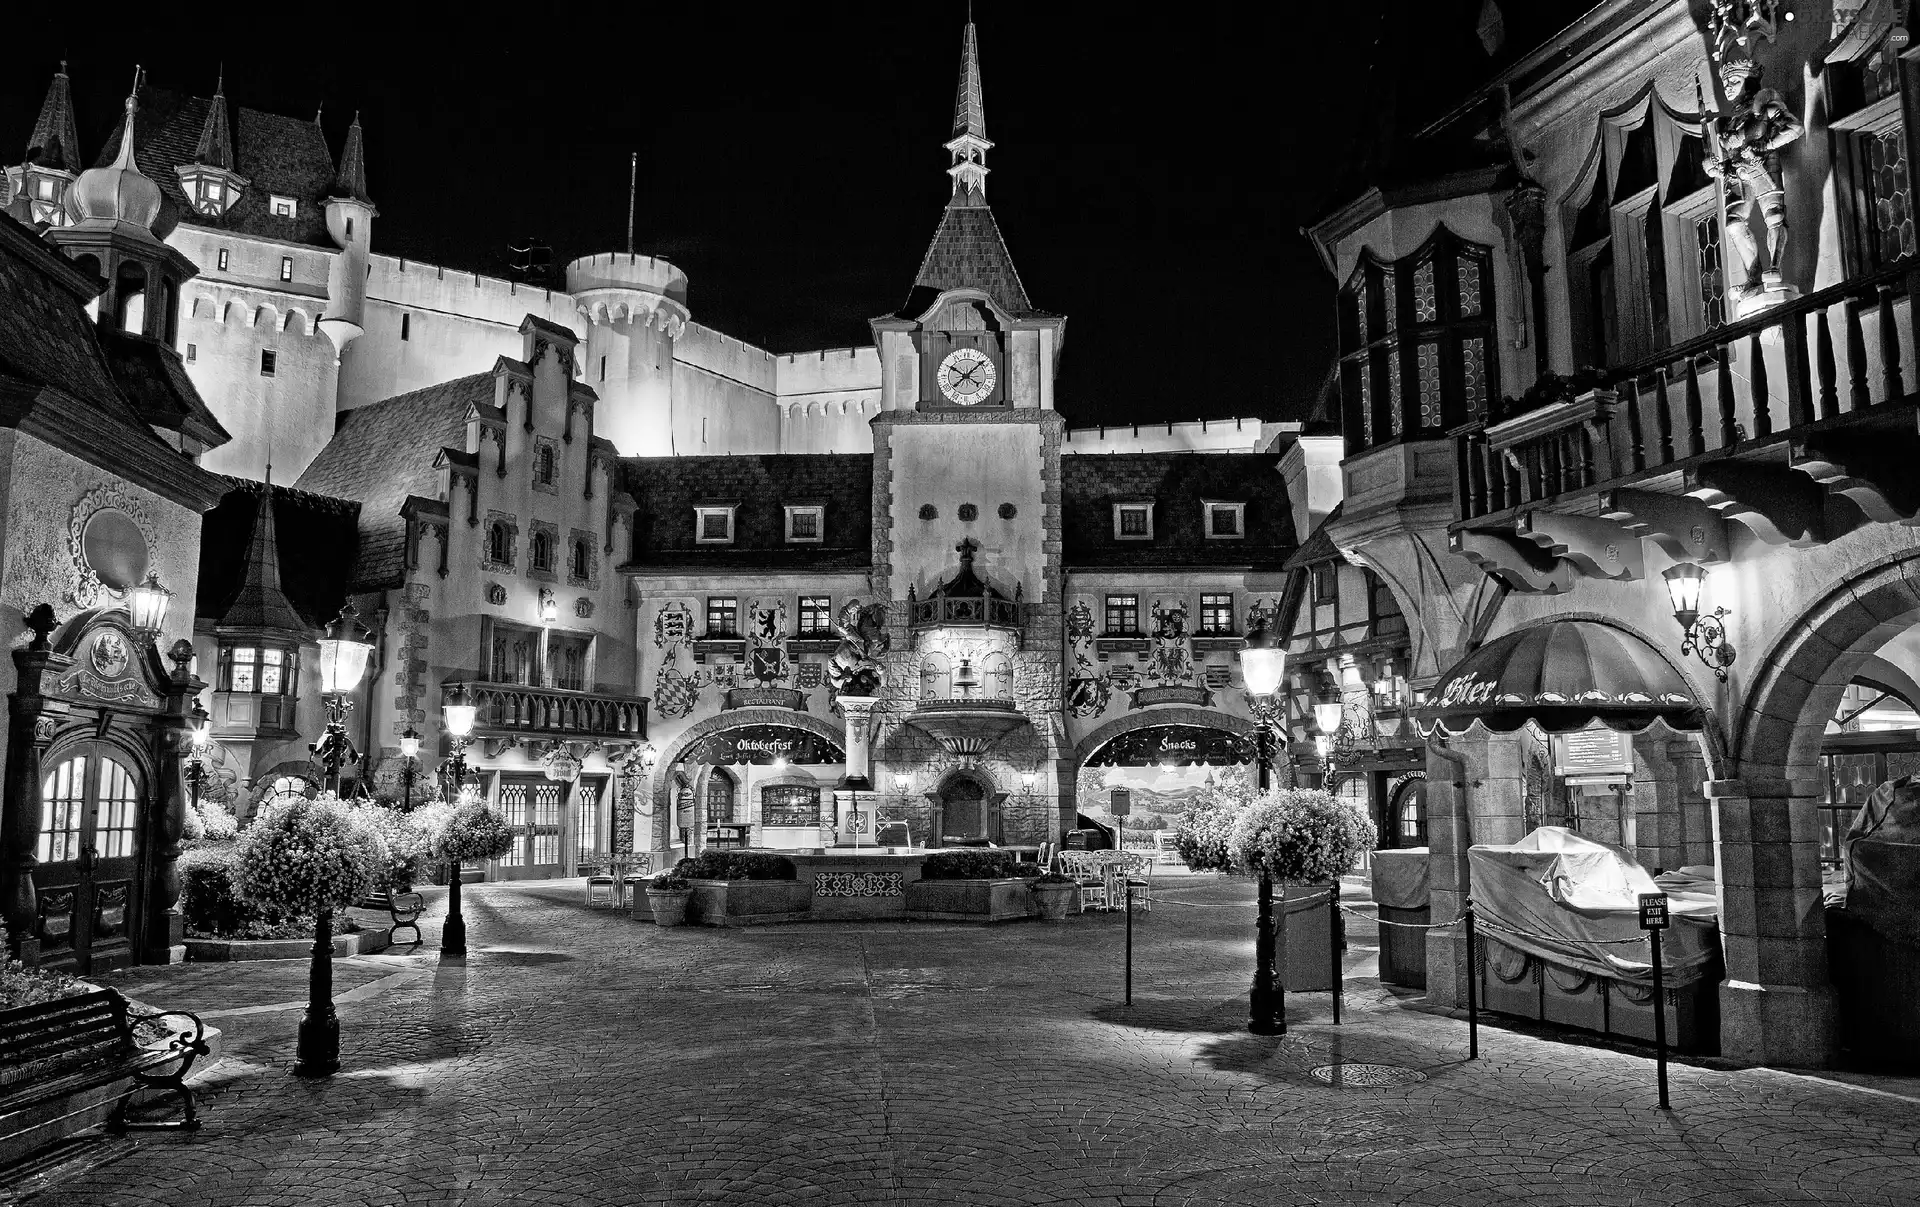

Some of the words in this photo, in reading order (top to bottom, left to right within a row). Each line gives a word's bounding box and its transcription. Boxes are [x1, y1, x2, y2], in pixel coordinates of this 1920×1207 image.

[1438, 672, 1497, 708] Bier
[743, 698, 786, 706] RESTAURANT
[736, 738, 793, 755] Oktoberfest
[1159, 735, 1197, 752] Snacks
[1641, 898, 1667, 907] PLEASE
[1647, 908, 1662, 916] EXIT
[1646, 917, 1664, 925] HERE
